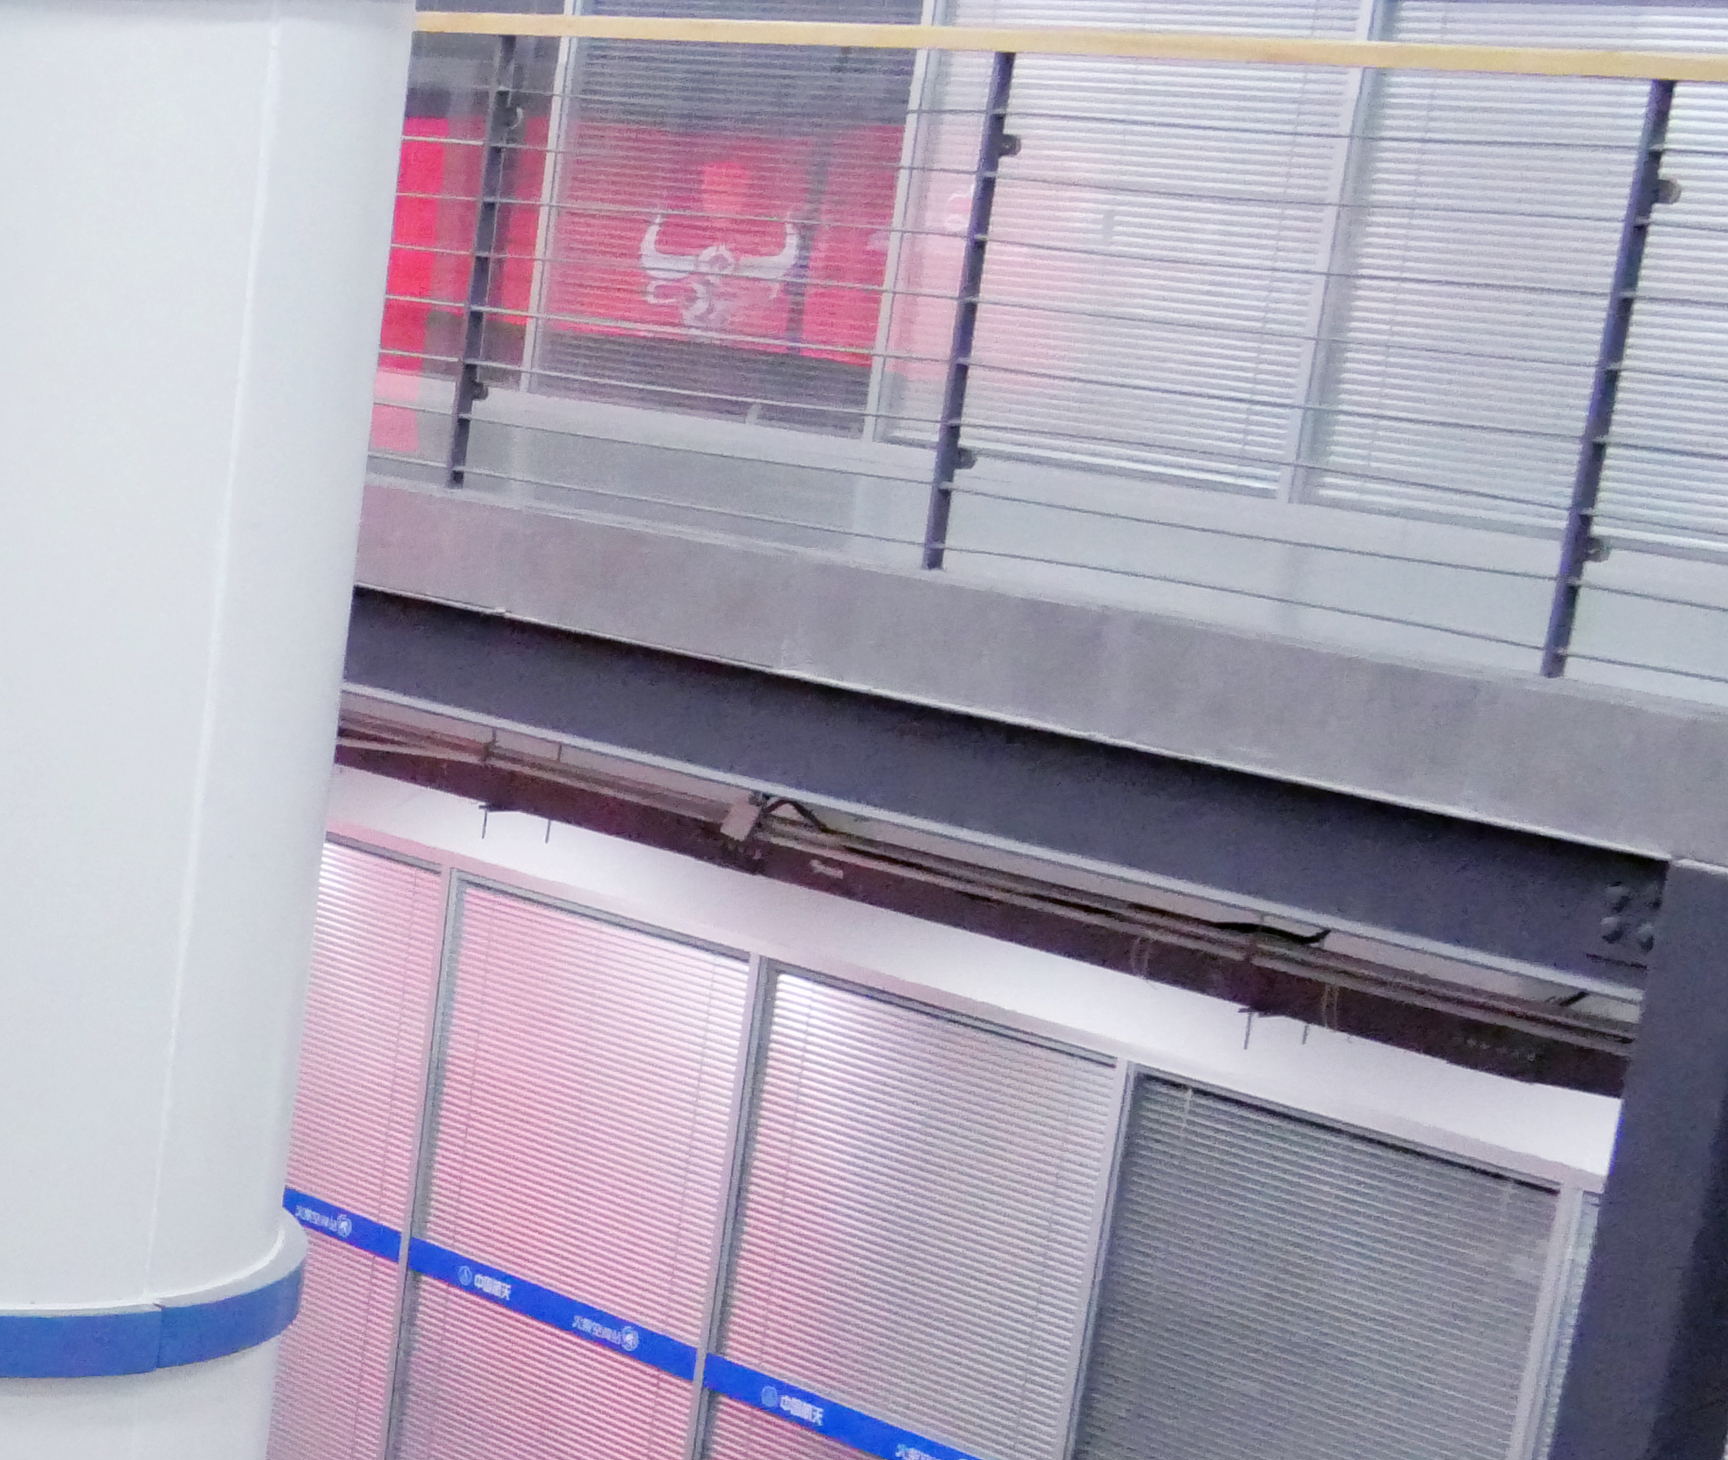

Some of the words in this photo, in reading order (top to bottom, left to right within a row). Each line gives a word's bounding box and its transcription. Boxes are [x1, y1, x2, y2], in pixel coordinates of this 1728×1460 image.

[474, 1274, 512, 1300] 中国航天
[780, 1395, 824, 1427] 中国航天
